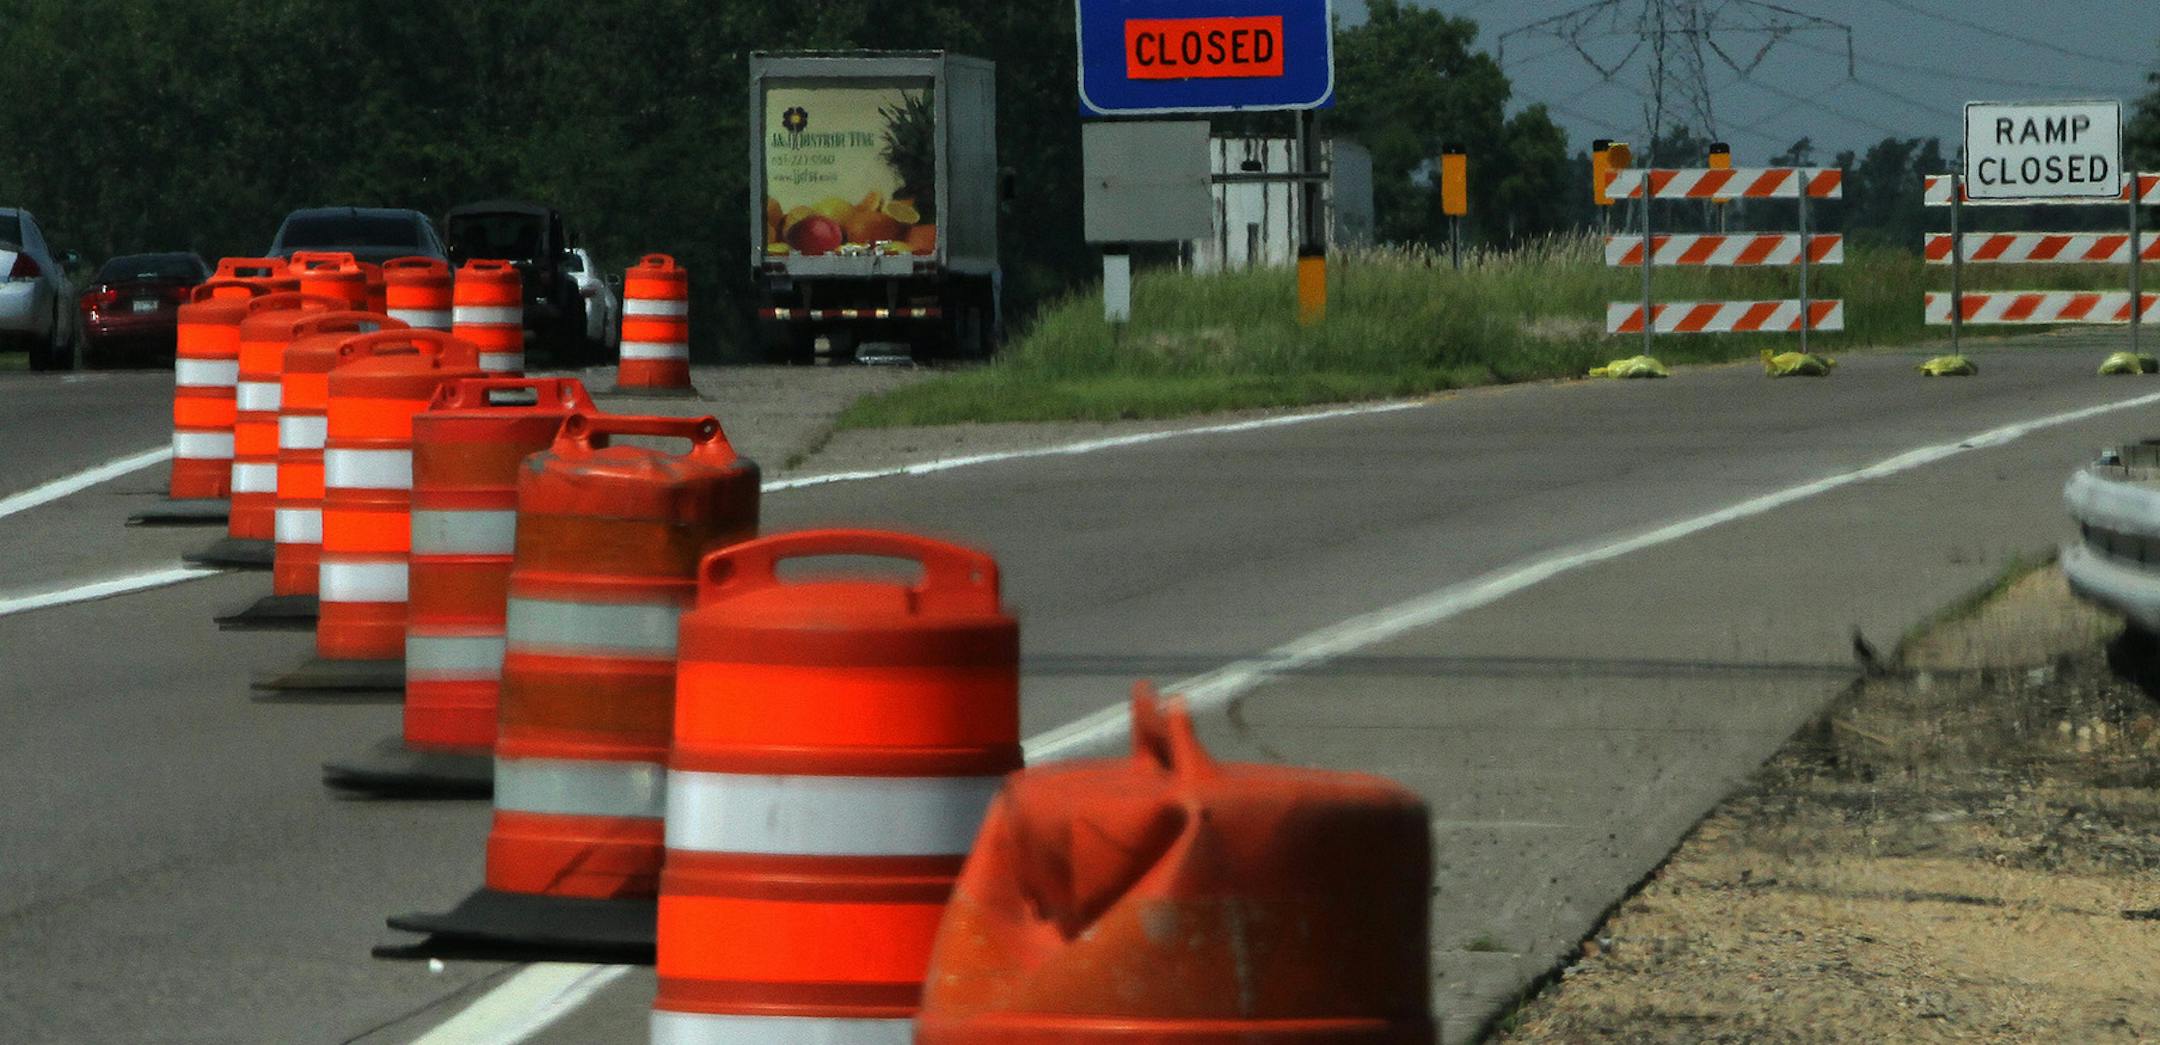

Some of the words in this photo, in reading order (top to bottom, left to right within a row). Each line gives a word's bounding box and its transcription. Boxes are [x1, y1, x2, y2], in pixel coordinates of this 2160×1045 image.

[1136, 29, 1274, 66] CLOSED
[1996, 115, 2090, 144] RAMP
[1978, 155, 2108, 185] CLOSED
